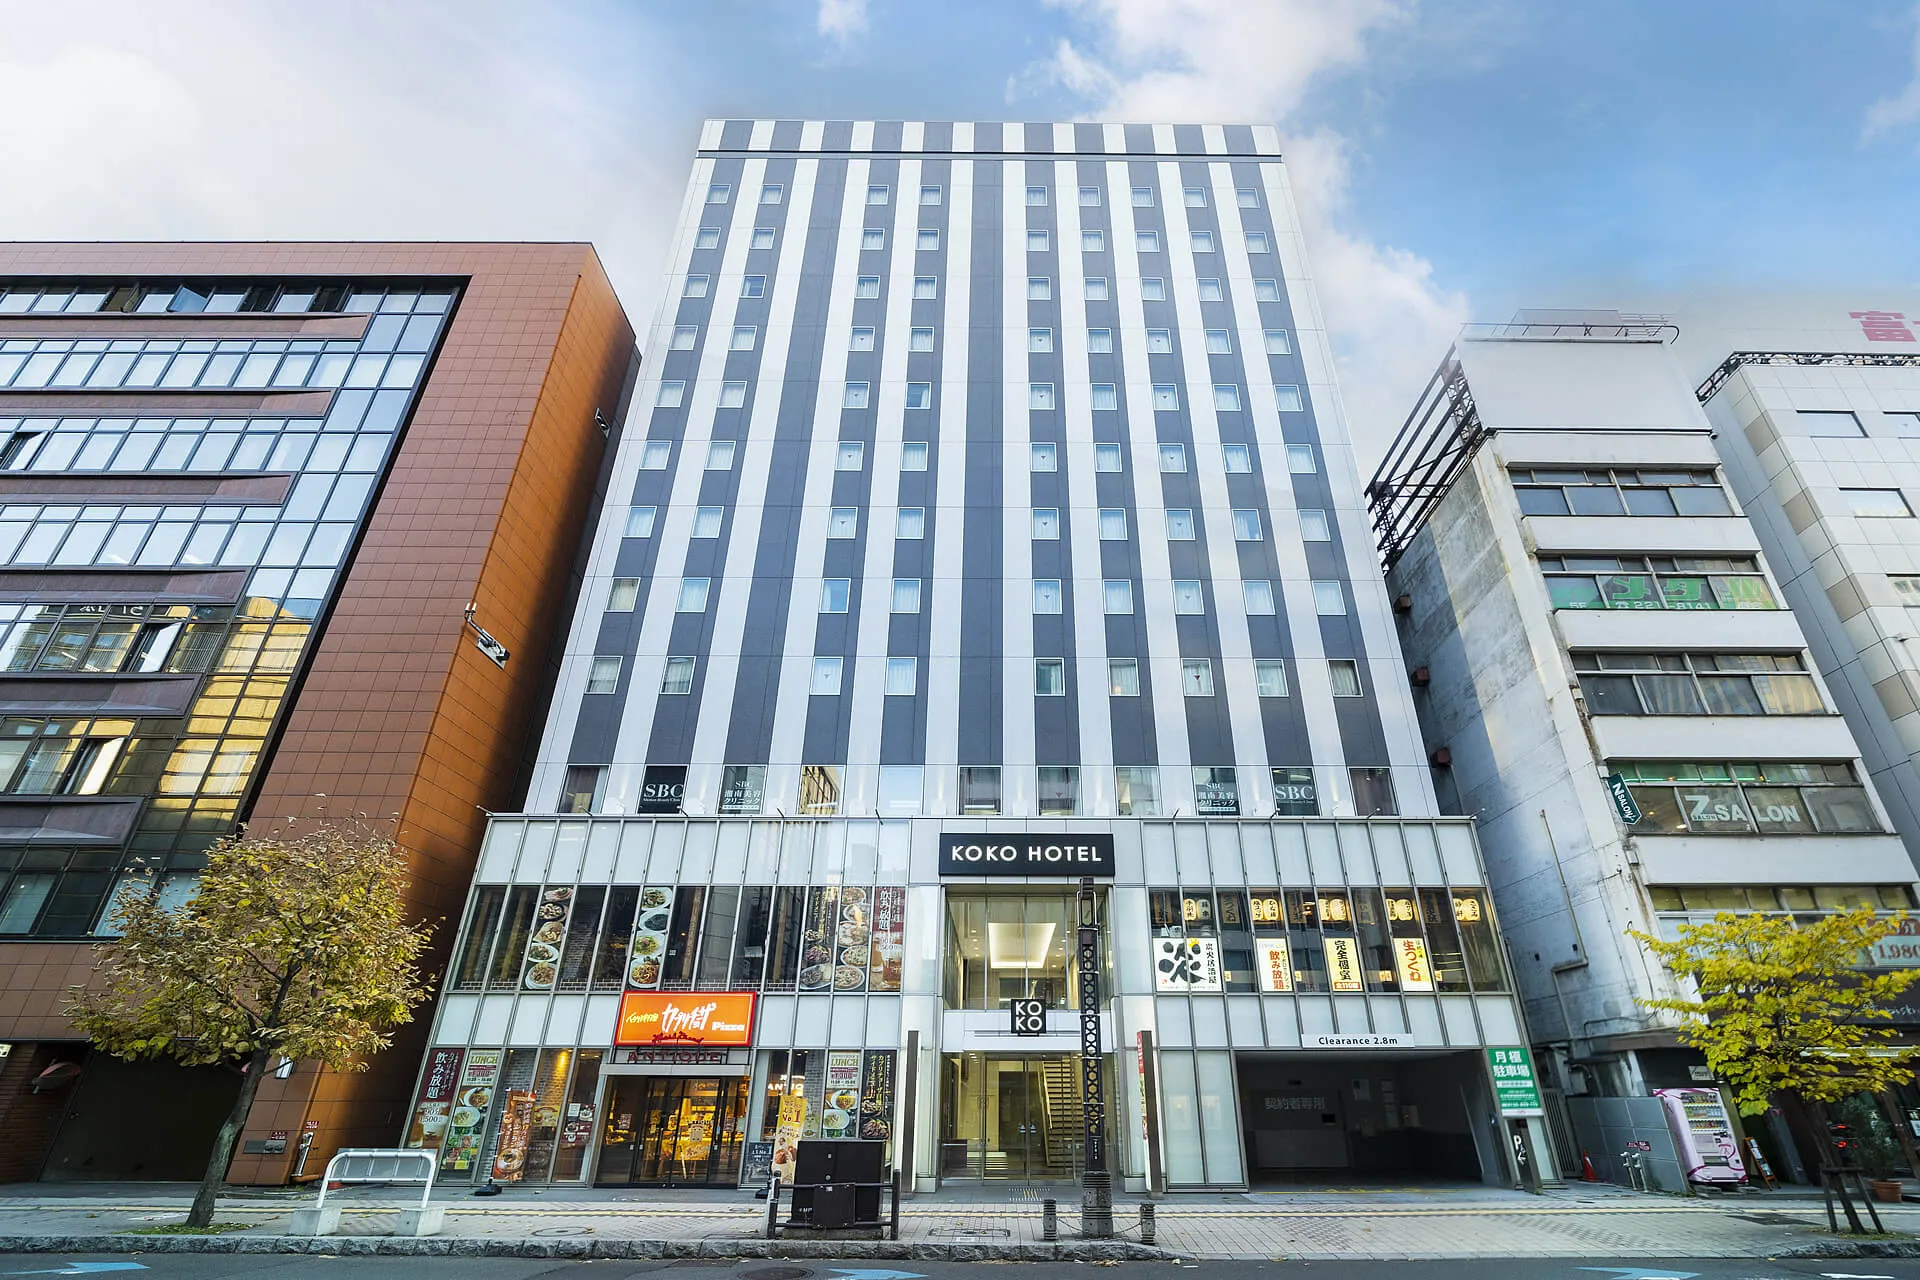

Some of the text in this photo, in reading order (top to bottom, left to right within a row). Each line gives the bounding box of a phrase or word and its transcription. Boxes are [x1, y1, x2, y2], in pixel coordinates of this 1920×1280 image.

[643, 784, 684, 797] SBC
[1206, 782, 1224, 790] SBC
[1276, 786, 1314, 799] SBC
[1714, 804, 1800, 822] SALON
[951, 845, 1102, 862] KOKO HOTEL
[1205, 943, 1217, 984] 炭火居酒屋
[1334, 940, 1352, 980] 完全個室
[1403, 939, 1422, 982] 生つくね
[1269, 950, 1284, 990] 飲み放題
[1015, 1001, 1042, 1015] KO
[1015, 1016, 1042, 1031] KO
[1318, 1037, 1398, 1045] Clearance 2.8m
[470, 1056, 497, 1064] LUNCH
[627, 1051, 722, 1063] ANTIQUE
[426, 1052, 447, 1099] 飲み放題
[1493, 1064, 1529, 1077] 駐車場
[1513, 1135, 1522, 1150] P
